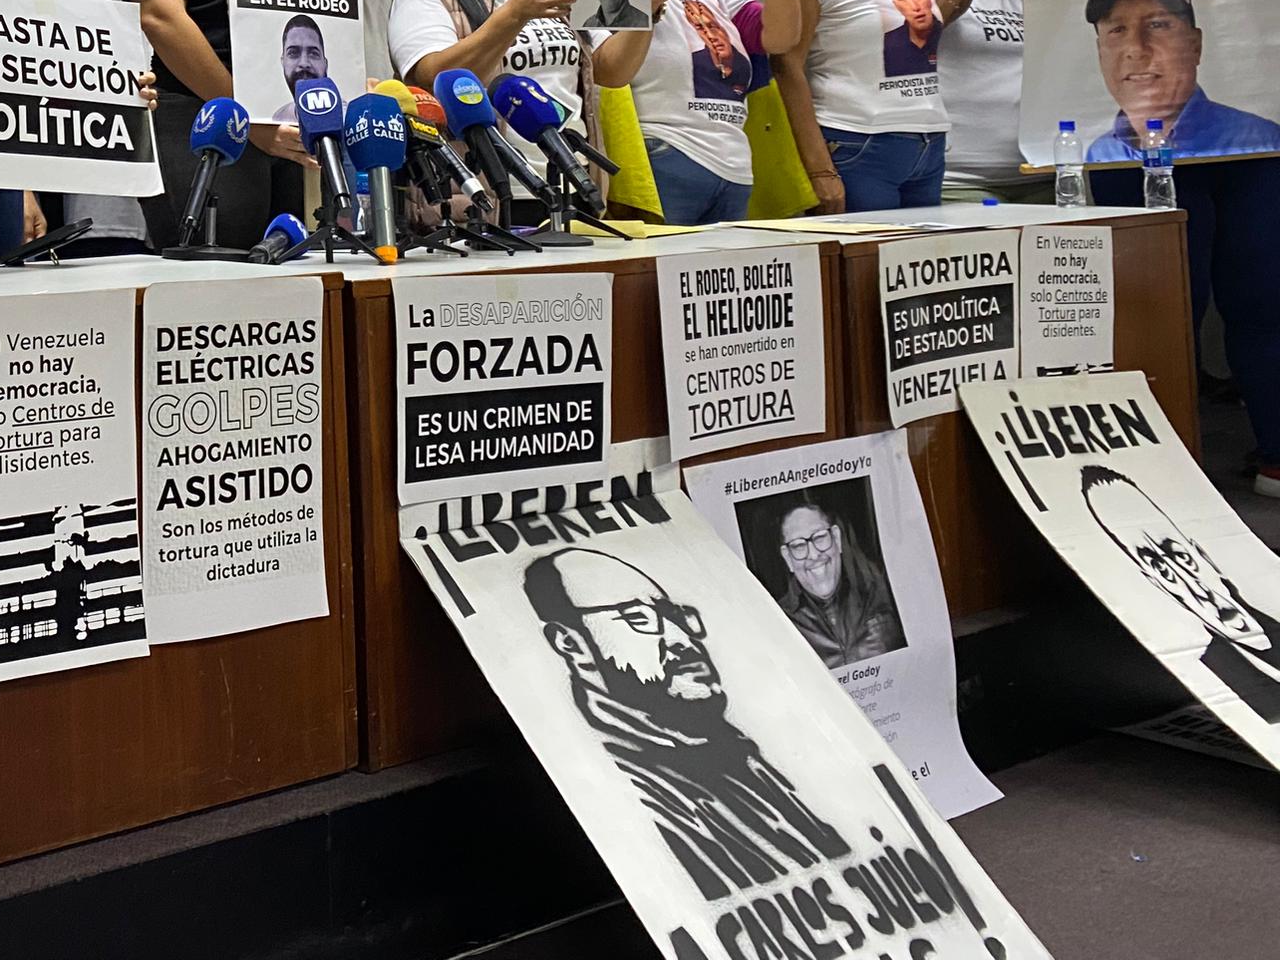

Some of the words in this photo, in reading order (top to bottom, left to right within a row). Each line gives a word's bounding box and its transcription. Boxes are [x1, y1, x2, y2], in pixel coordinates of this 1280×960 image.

[76, 26, 113, 55] DE
[307, 91, 330, 110] M
[879, 78, 923, 90] PERIODISTA
[347, 129, 369, 146] CALLE
[374, 128, 404, 141] CALLE
[680, 272, 692, 298] EL
[696, 268, 739, 296] RODEO,
[744, 258, 792, 291] BOLEÍTA
[409, 304, 436, 329] La
[439, 293, 602, 327] DESAPARICIÓN
[683, 303, 701, 340] EL
[706, 293, 793, 337] HELICOIDE
[894, 313, 907, 331] ES
[911, 307, 930, 327] UN
[934, 296, 1000, 323] POLÍTICA
[6, 328, 105, 352] Venezuela
[157, 320, 316, 352] DESCARGAS
[685, 350, 696, 362] se
[699, 346, 717, 360] han
[722, 337, 777, 356] convertido
[781, 337, 795, 348] en
[896, 340, 911, 359] DE
[915, 327, 968, 353] ESTADO
[973, 324, 993, 343] EN
[9, 358, 34, 376] no
[40, 355, 74, 374] hay
[157, 351, 314, 386] ELÉCTRICAS
[407, 334, 602, 384] FORZADA
[687, 363, 765, 396] CENTROS
[772, 360, 795, 381] DE
[12, 401, 87, 424] Centros
[92, 397, 115, 416] de
[147, 383, 319, 437] GOLPES
[688, 389, 794, 433] TORTURA
[157, 434, 312, 468] AHOGAMIENTO
[415, 443, 465, 468] LESA
[470, 429, 593, 462] HUMANIDAD
[156, 464, 313, 511] ASISTIDO
[162, 522, 194, 539] Son
[199, 517, 223, 535] los
[227, 509, 293, 531] métodos
[297, 505, 314, 521] de
[158, 543, 219, 564] tortura
[224, 540, 253, 559] que
[257, 529, 301, 552] utiliza
[305, 528, 317, 542] la
[206, 556, 279, 581] dictadura
[852, 665, 880, 680] Godoy
